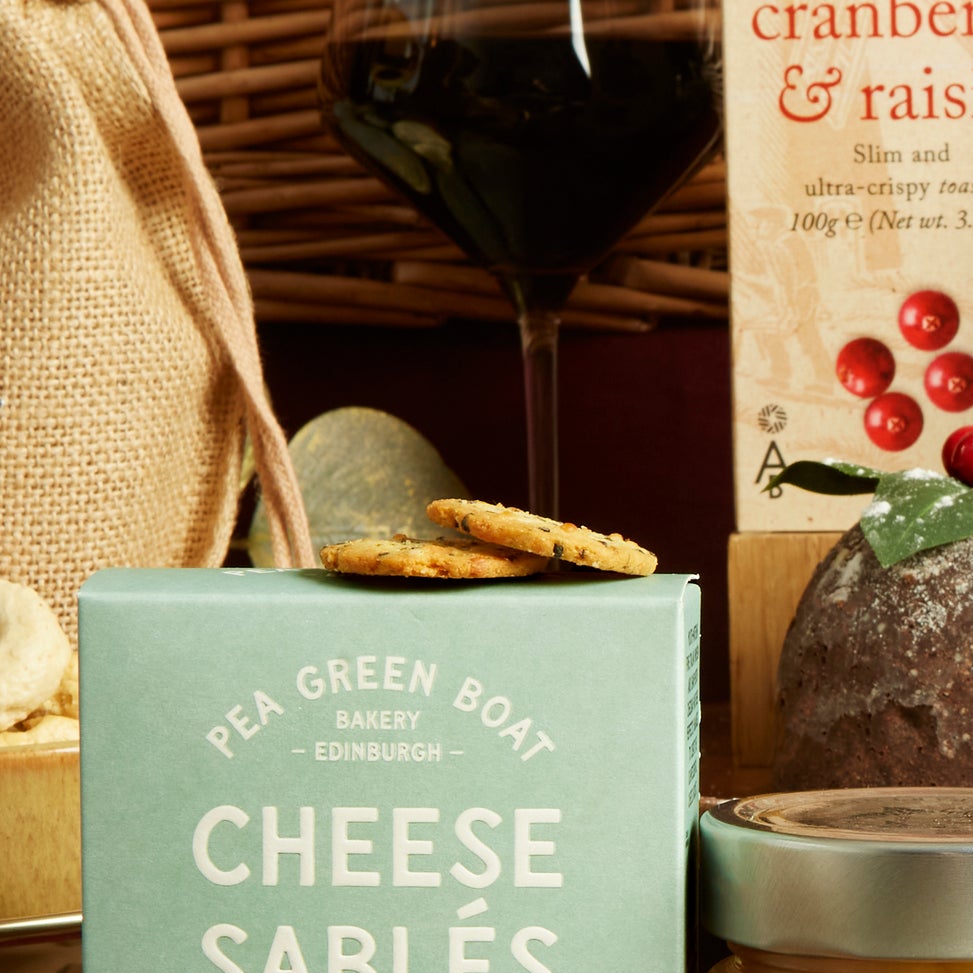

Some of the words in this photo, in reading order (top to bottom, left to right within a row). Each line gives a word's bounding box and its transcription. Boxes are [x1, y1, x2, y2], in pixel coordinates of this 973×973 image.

[779, 65, 842, 123] &
[853, 143, 903, 164] Slim
[912, 142, 950, 163] and
[804, 177, 932, 201] ultra-crispy
[791, 212, 839, 237] 100g
[869, 209, 912, 235] (Net
[918, 214, 948, 231] wt.
[205, 689, 284, 760] PEA
[296, 655, 438, 701] GREEN
[452, 676, 557, 763] BOAT
[335, 709, 421, 732] BAKERY
[314, 741, 443, 763] EDINBURGH
[192, 804, 563, 889] CHEESE
